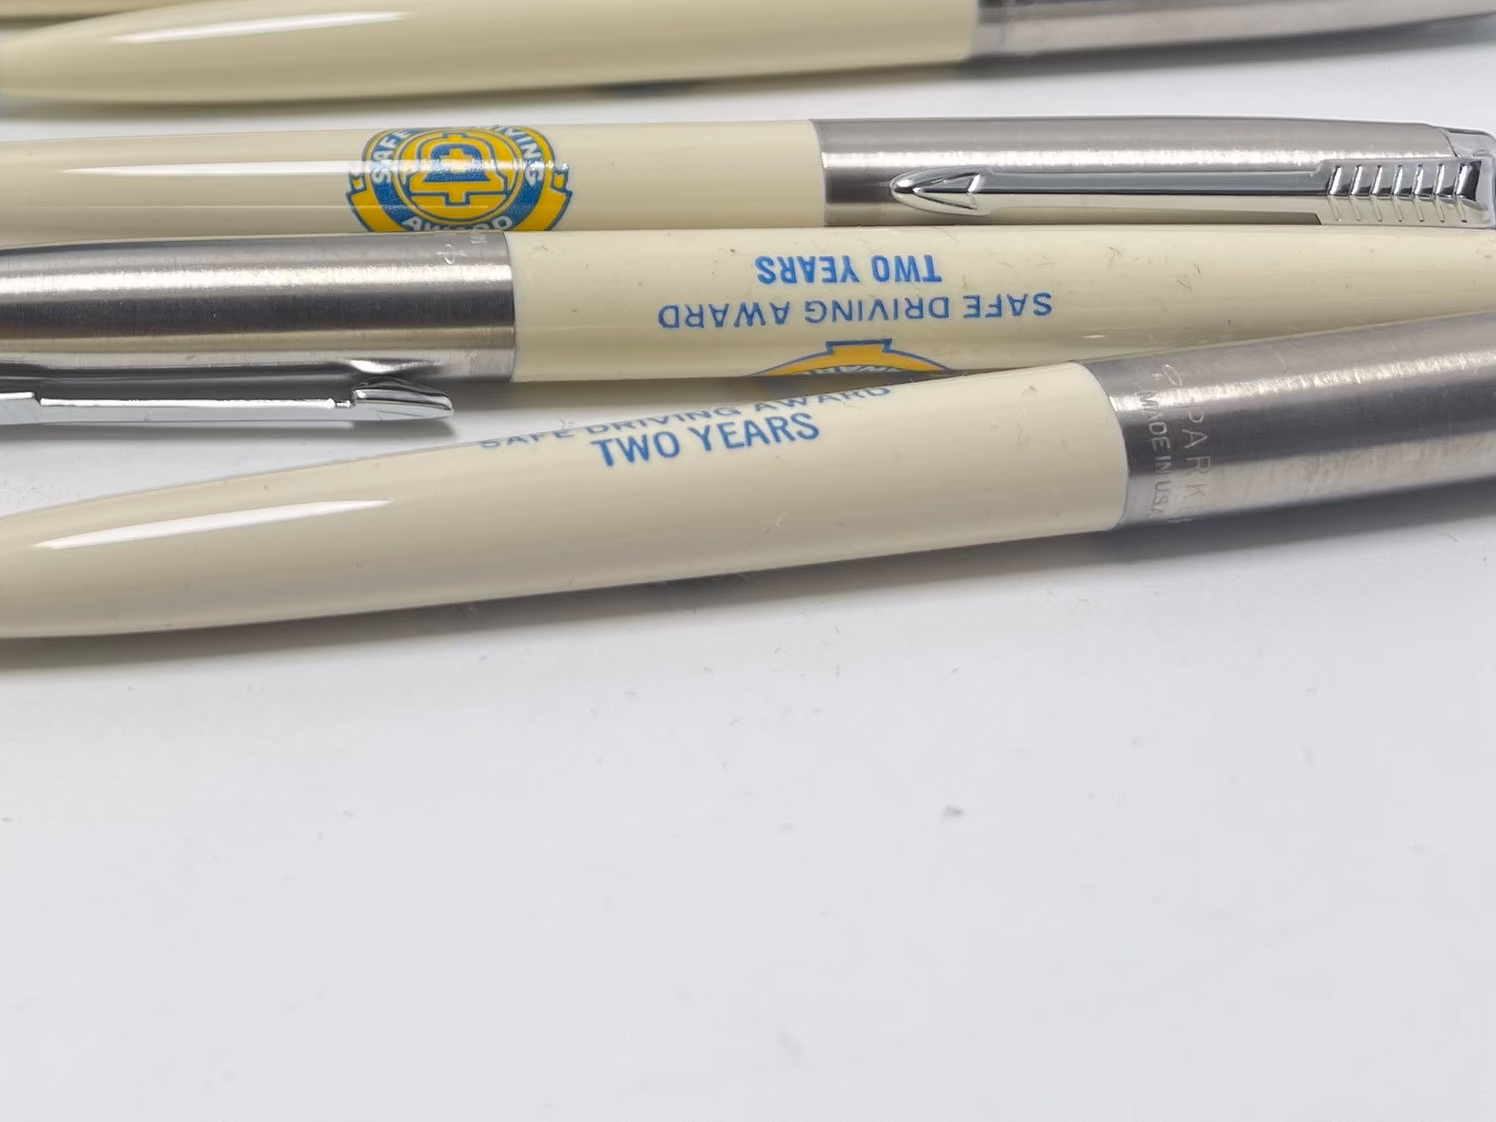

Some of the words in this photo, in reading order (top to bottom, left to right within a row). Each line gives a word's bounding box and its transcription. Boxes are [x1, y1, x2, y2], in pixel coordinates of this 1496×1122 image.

[754, 255, 860, 285] YEARS
[871, 254, 942, 283] TWO
[657, 300, 791, 330] AWARD
[804, 296, 951, 324] DRIVING
[962, 292, 1052, 319] SAFE
[479, 428, 576, 450] SAFE
[584, 406, 744, 436] DRIVING
[1134, 390, 1172, 451] MADE
[590, 428, 682, 468] TWO
[687, 412, 821, 455] YEARS
